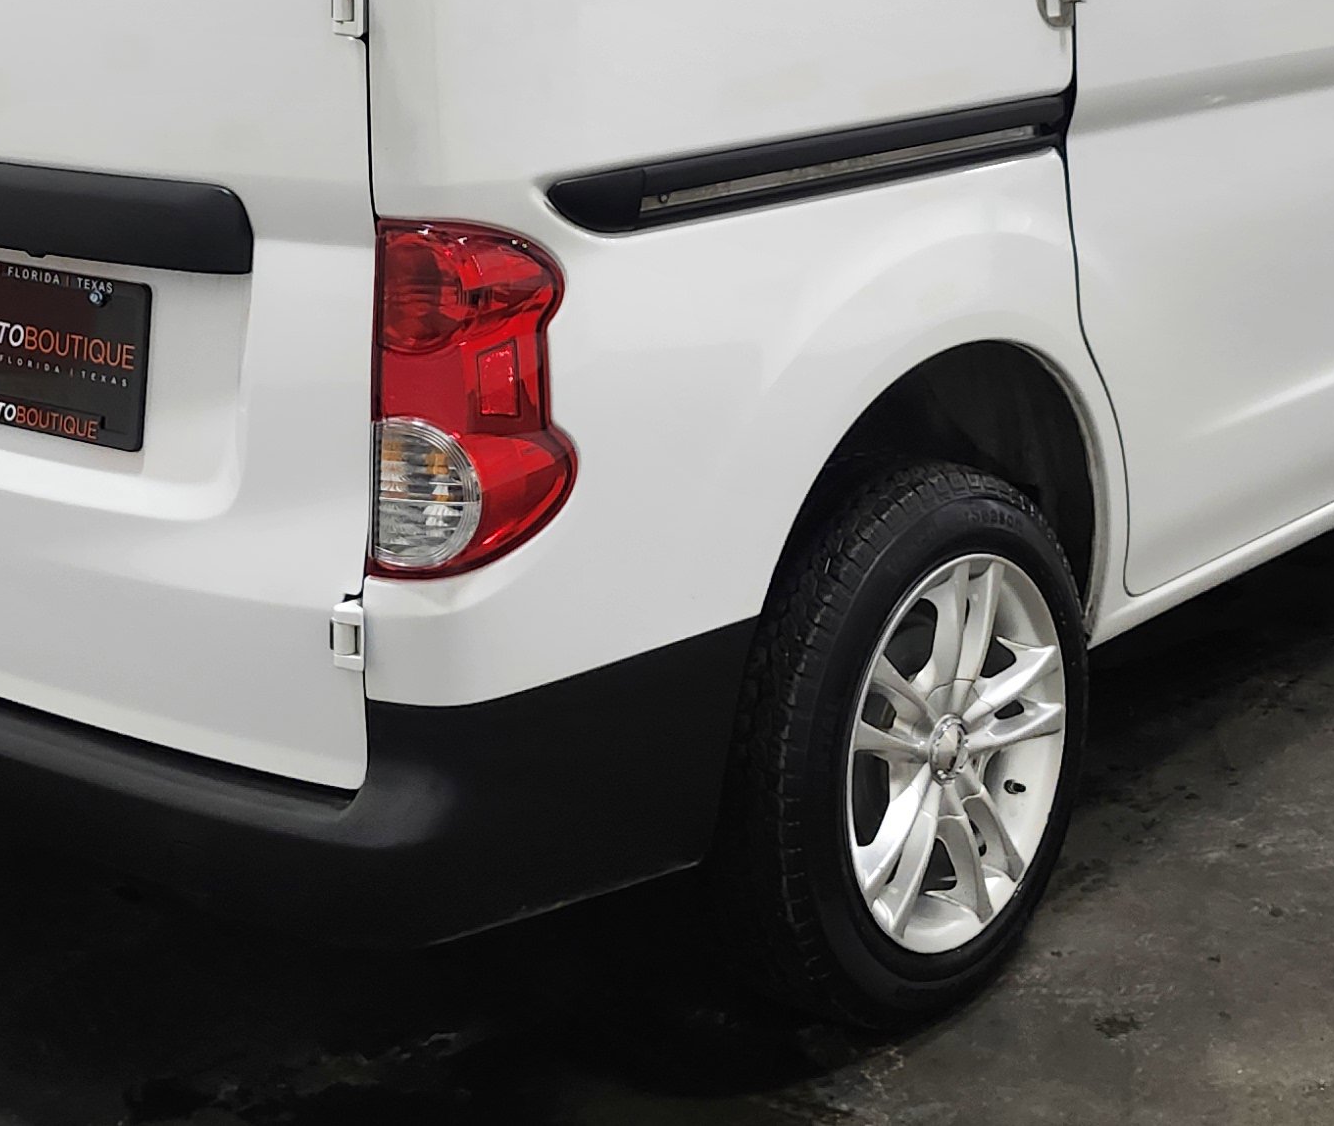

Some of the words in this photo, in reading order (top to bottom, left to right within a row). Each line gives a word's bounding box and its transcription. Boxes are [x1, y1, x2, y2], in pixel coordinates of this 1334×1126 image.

[7, 266, 60, 285] FLORIDA
[77, 277, 113, 294] TEXAS
[81, 370, 128, 388] TEXAS
